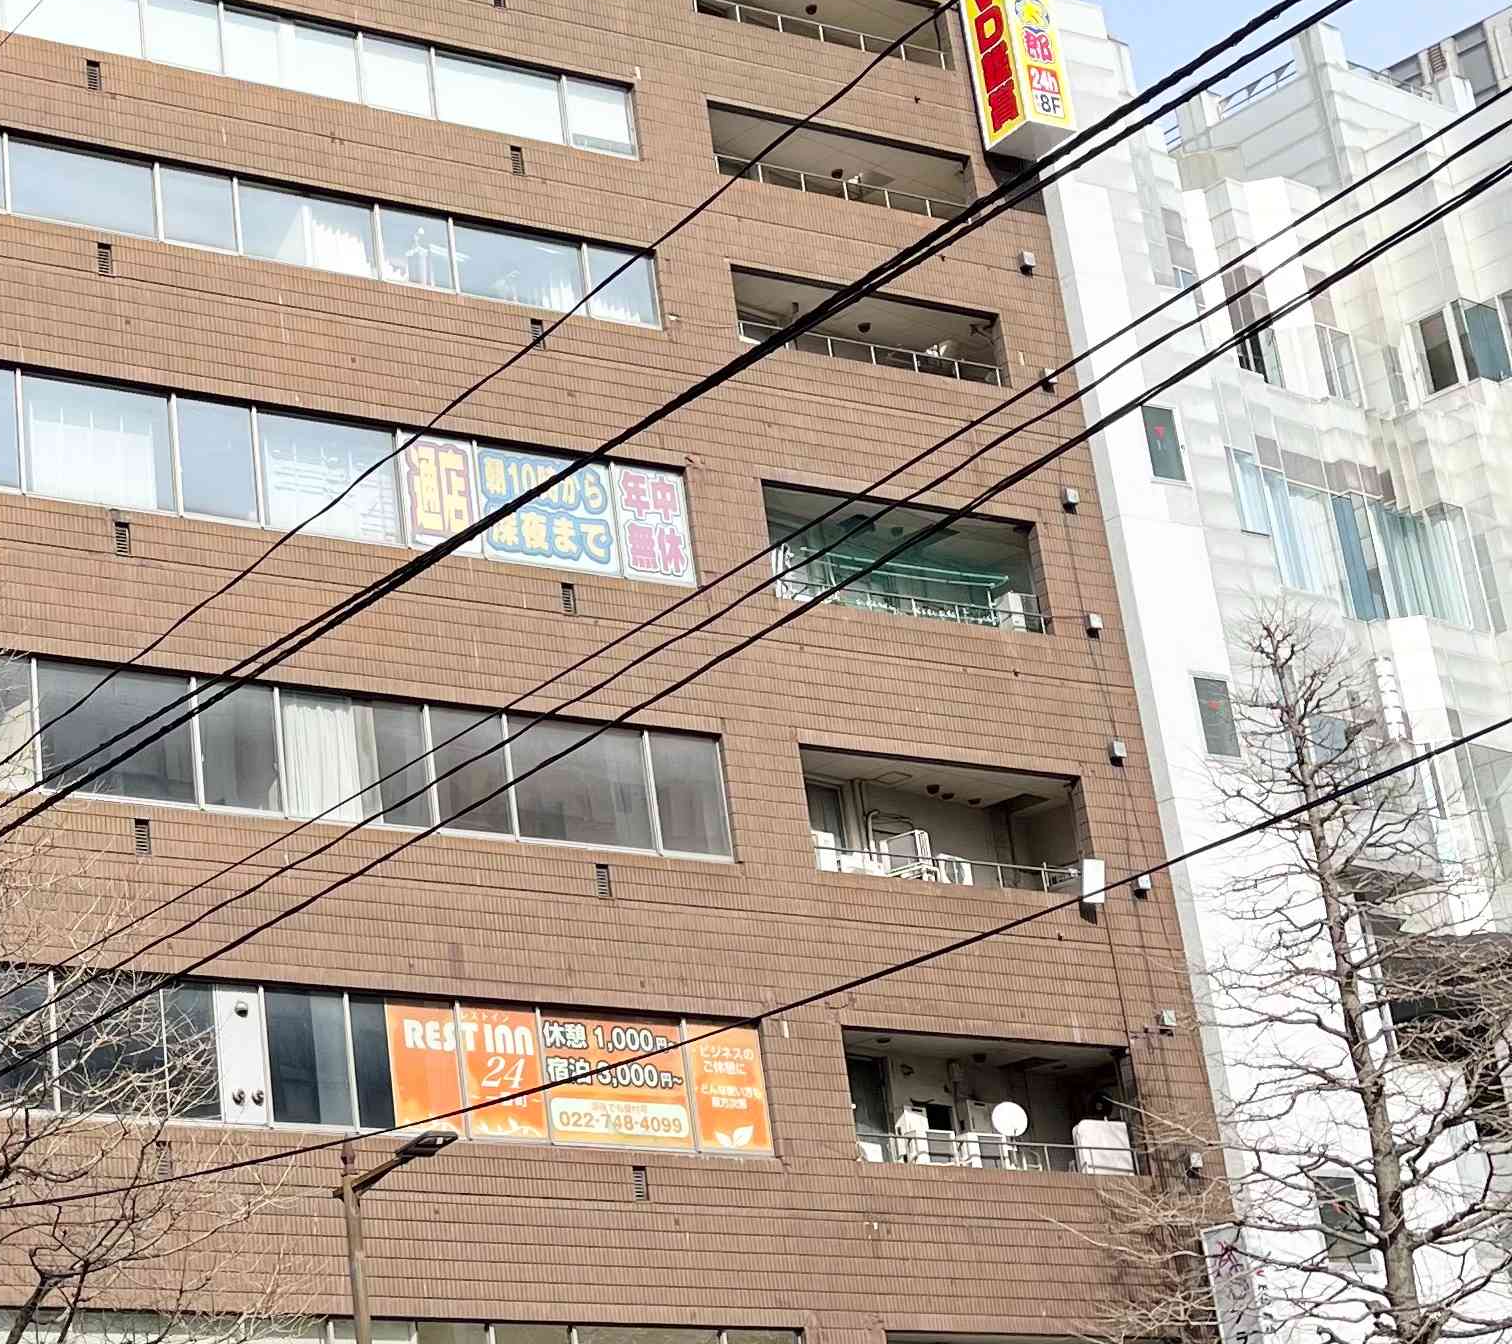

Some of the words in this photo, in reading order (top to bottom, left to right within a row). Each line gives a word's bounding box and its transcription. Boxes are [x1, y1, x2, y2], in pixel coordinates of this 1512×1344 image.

[620, 470, 680, 522] 年中
[626, 523, 687, 575] 無休
[402, 1018, 478, 1052] REST
[542, 1019, 588, 1049] 休憩
[481, 1055, 526, 1089] 24
[545, 1055, 593, 1086] 宿泊
